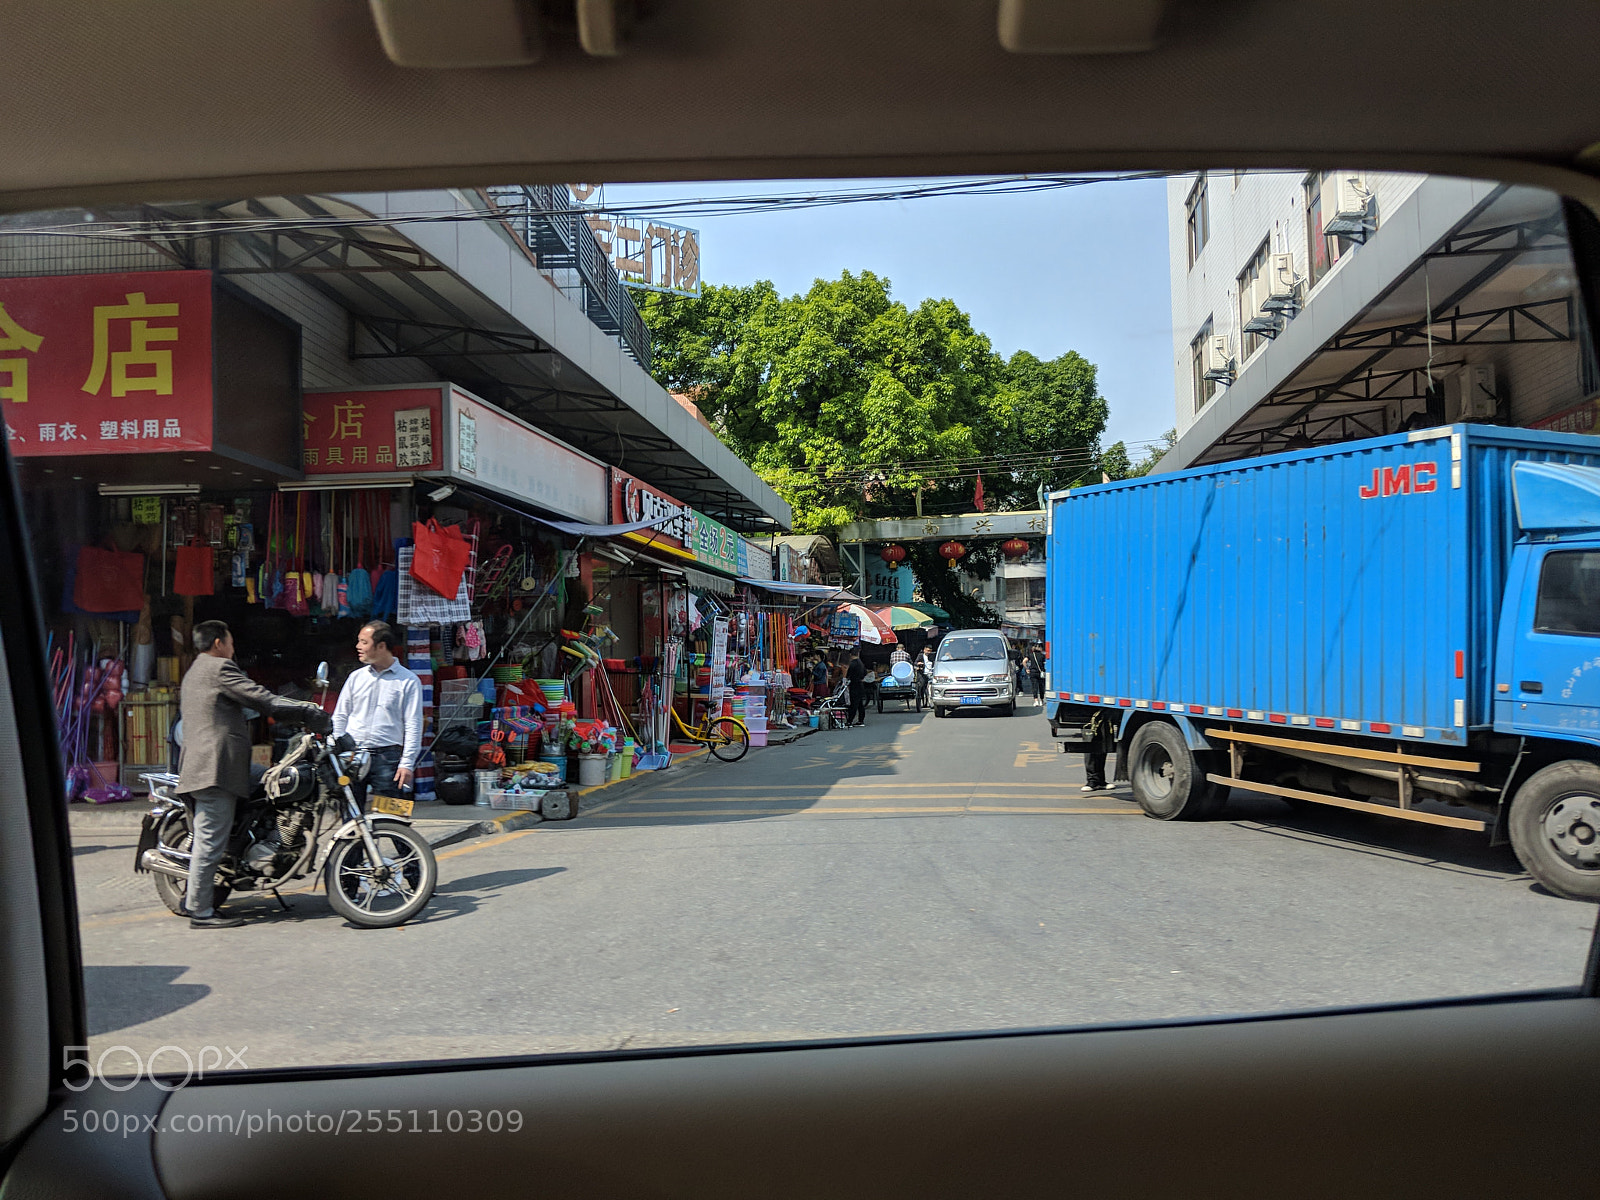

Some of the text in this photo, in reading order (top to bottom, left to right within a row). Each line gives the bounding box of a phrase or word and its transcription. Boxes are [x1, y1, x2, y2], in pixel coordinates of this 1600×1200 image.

[303, 445, 393, 466] 雨具用品
[1359, 461, 1438, 500] JMC
[699, 521, 735, 561] 全场2元
[922, 516, 1046, 536] 南兴村
